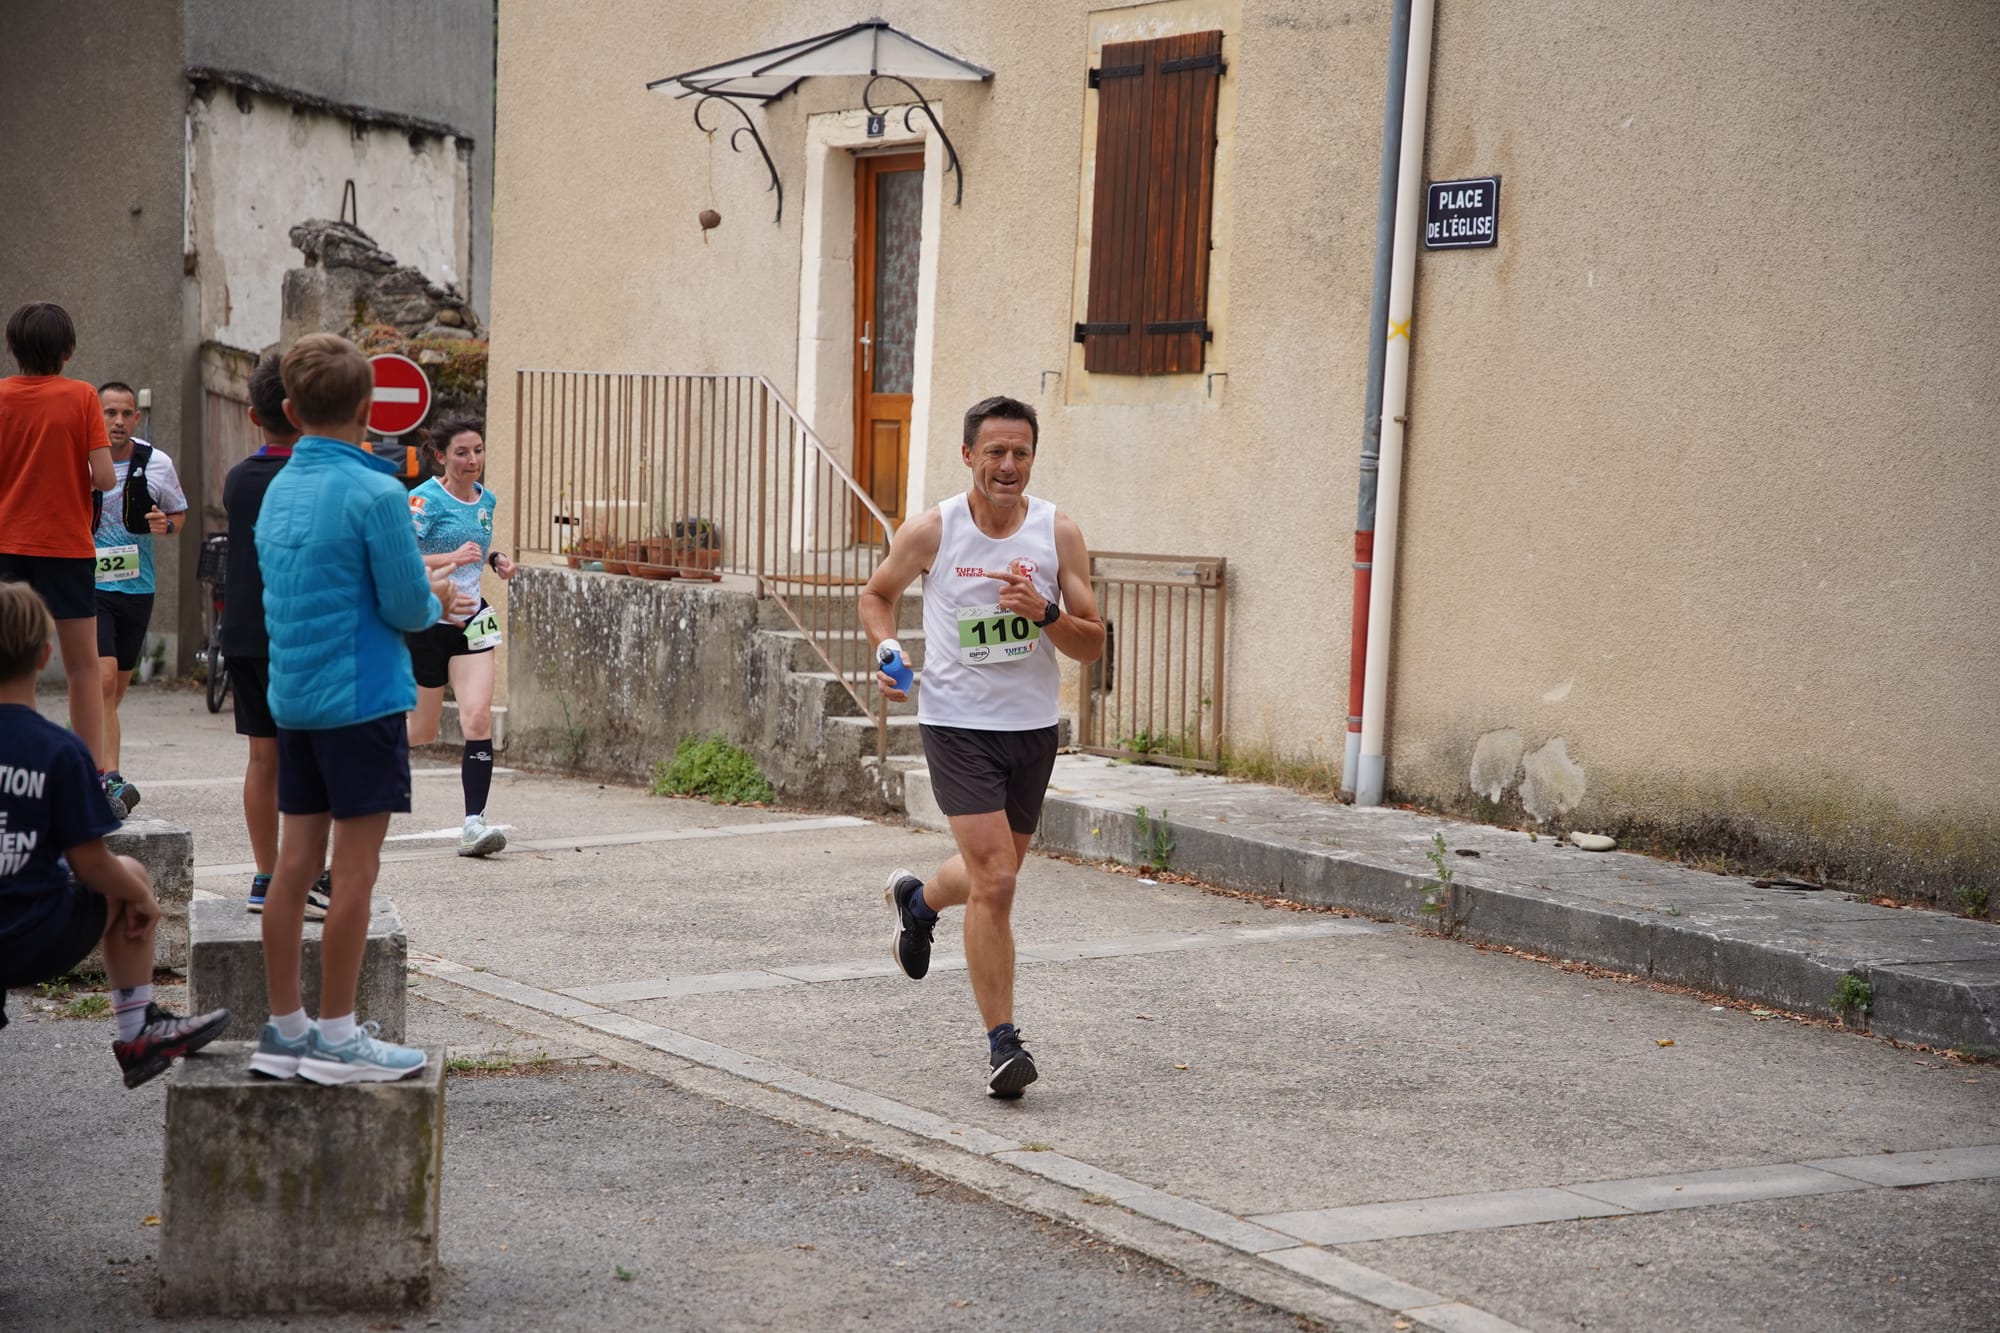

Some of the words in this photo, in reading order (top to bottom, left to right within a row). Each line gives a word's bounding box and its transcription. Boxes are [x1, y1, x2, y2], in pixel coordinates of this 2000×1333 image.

[872, 118, 879, 133] 6
[1439, 189, 1483, 210] PLACE
[1428, 222, 1440, 239] DE
[1442, 214, 1492, 237] L'ÉGLISE
[95, 556, 126, 572] 32
[473, 616, 498, 635] 74
[971, 616, 1029, 645] 110
